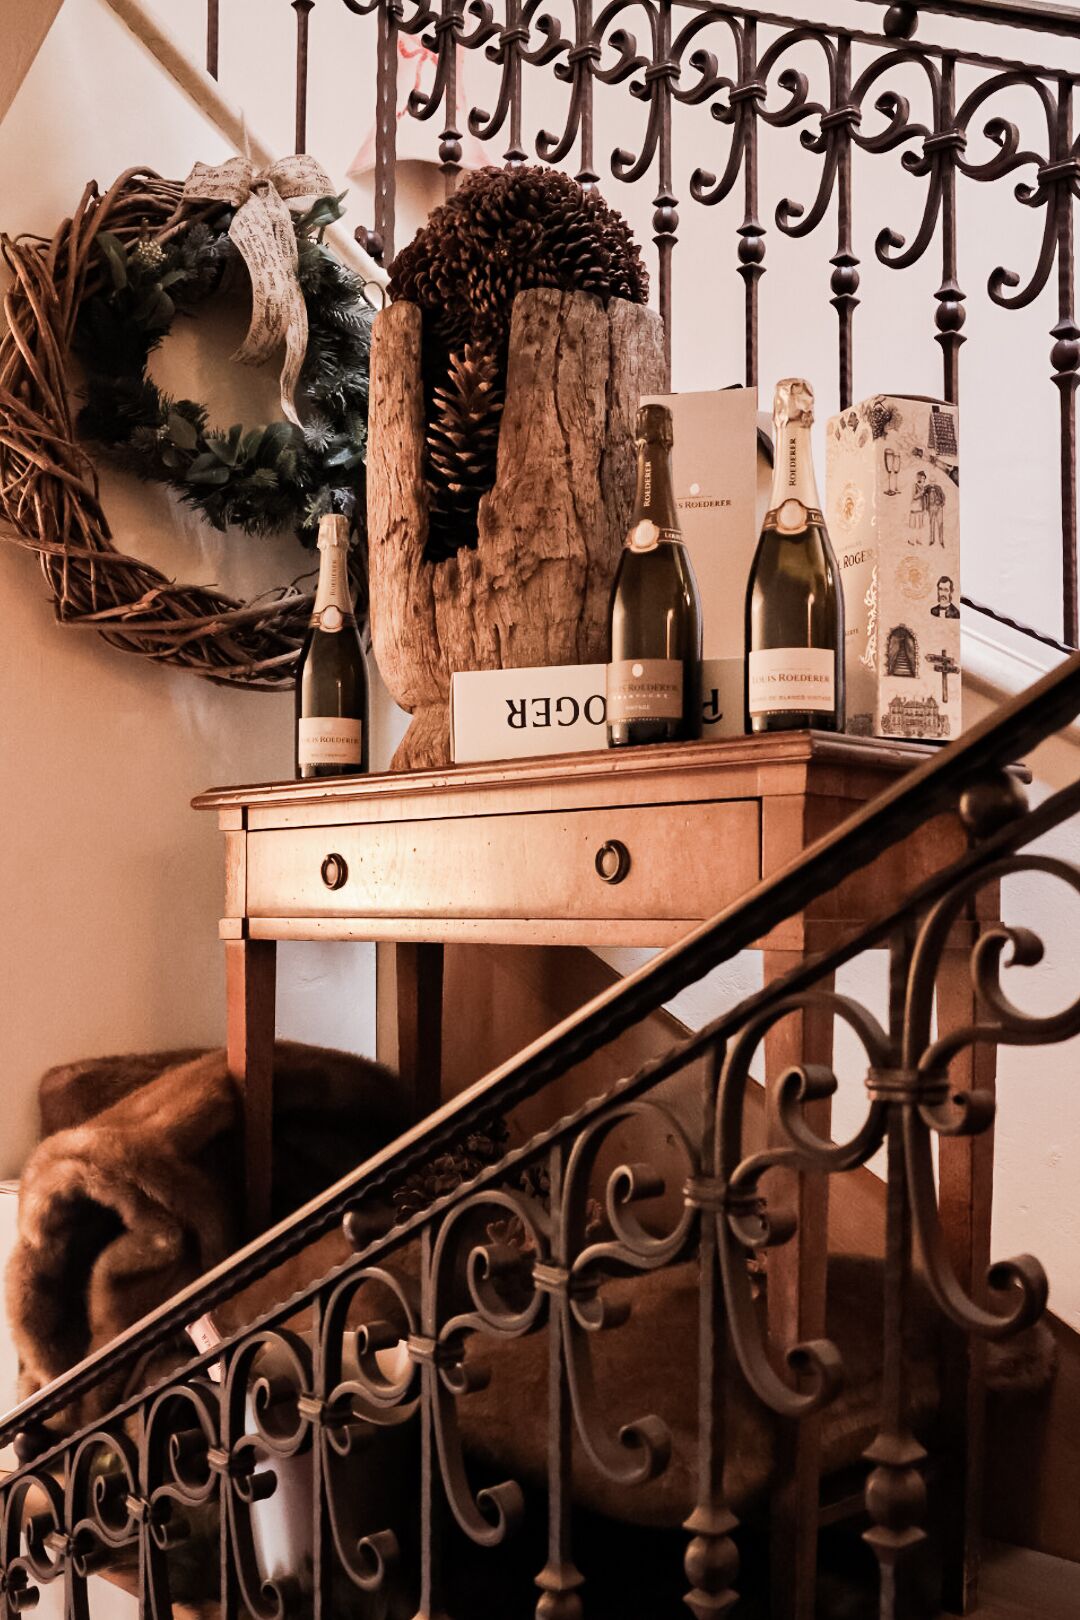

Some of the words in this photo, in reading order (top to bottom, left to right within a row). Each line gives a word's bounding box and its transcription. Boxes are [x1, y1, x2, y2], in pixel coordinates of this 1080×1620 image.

[788, 438, 797, 487] ROEDERER
[643, 461, 652, 507] ROEDERER
[685, 499, 732, 509] ROEDERER
[778, 673, 830, 682] ROEDERER
[506, 694, 608, 730] OGER
